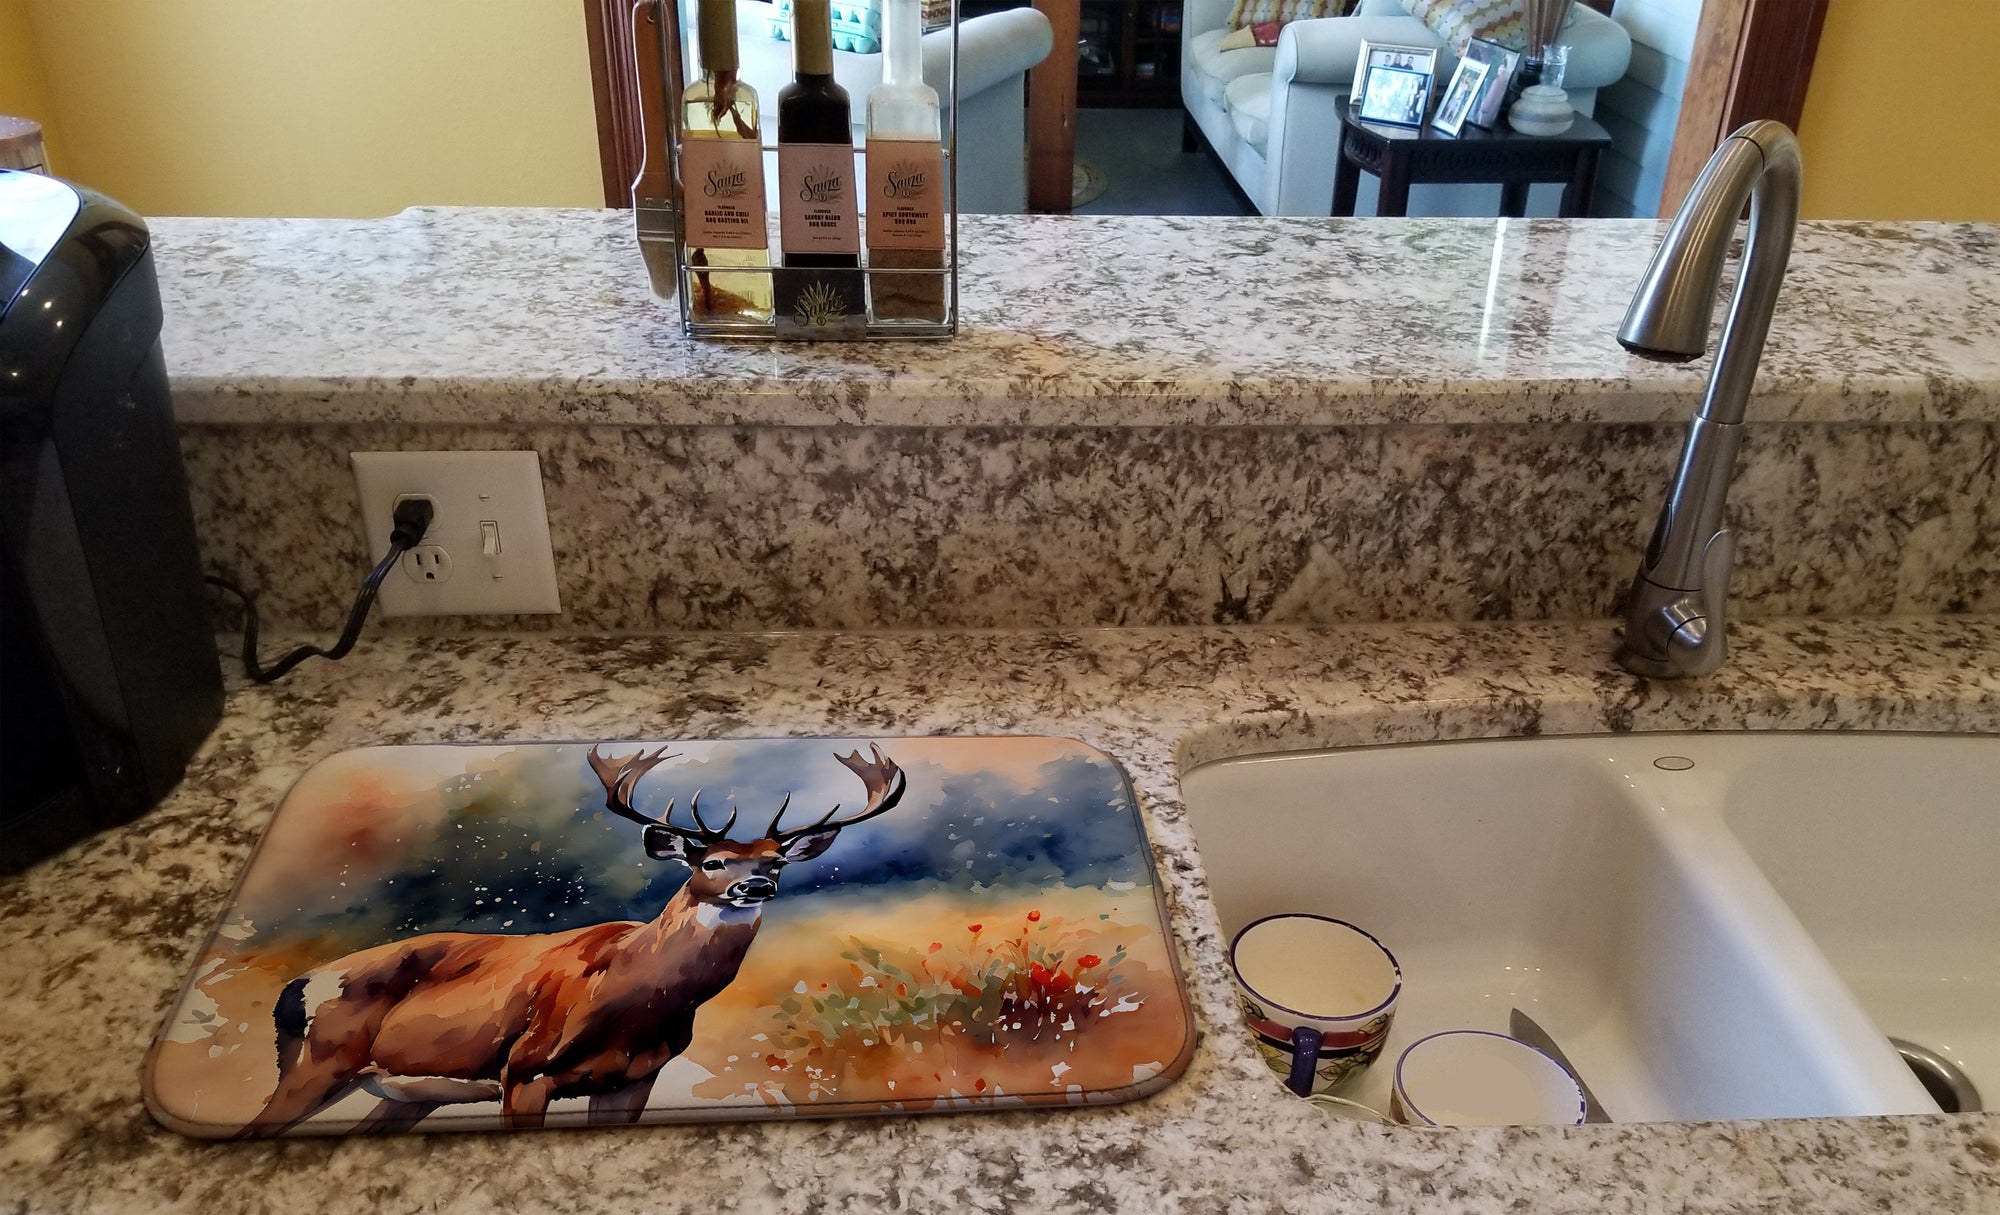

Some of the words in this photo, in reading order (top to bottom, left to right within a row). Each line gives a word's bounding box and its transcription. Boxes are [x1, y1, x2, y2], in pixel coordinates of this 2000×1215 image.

[704, 170, 745, 197] Sauza
[800, 175, 841, 202] Sauza
[884, 171, 924, 198] Sauza
